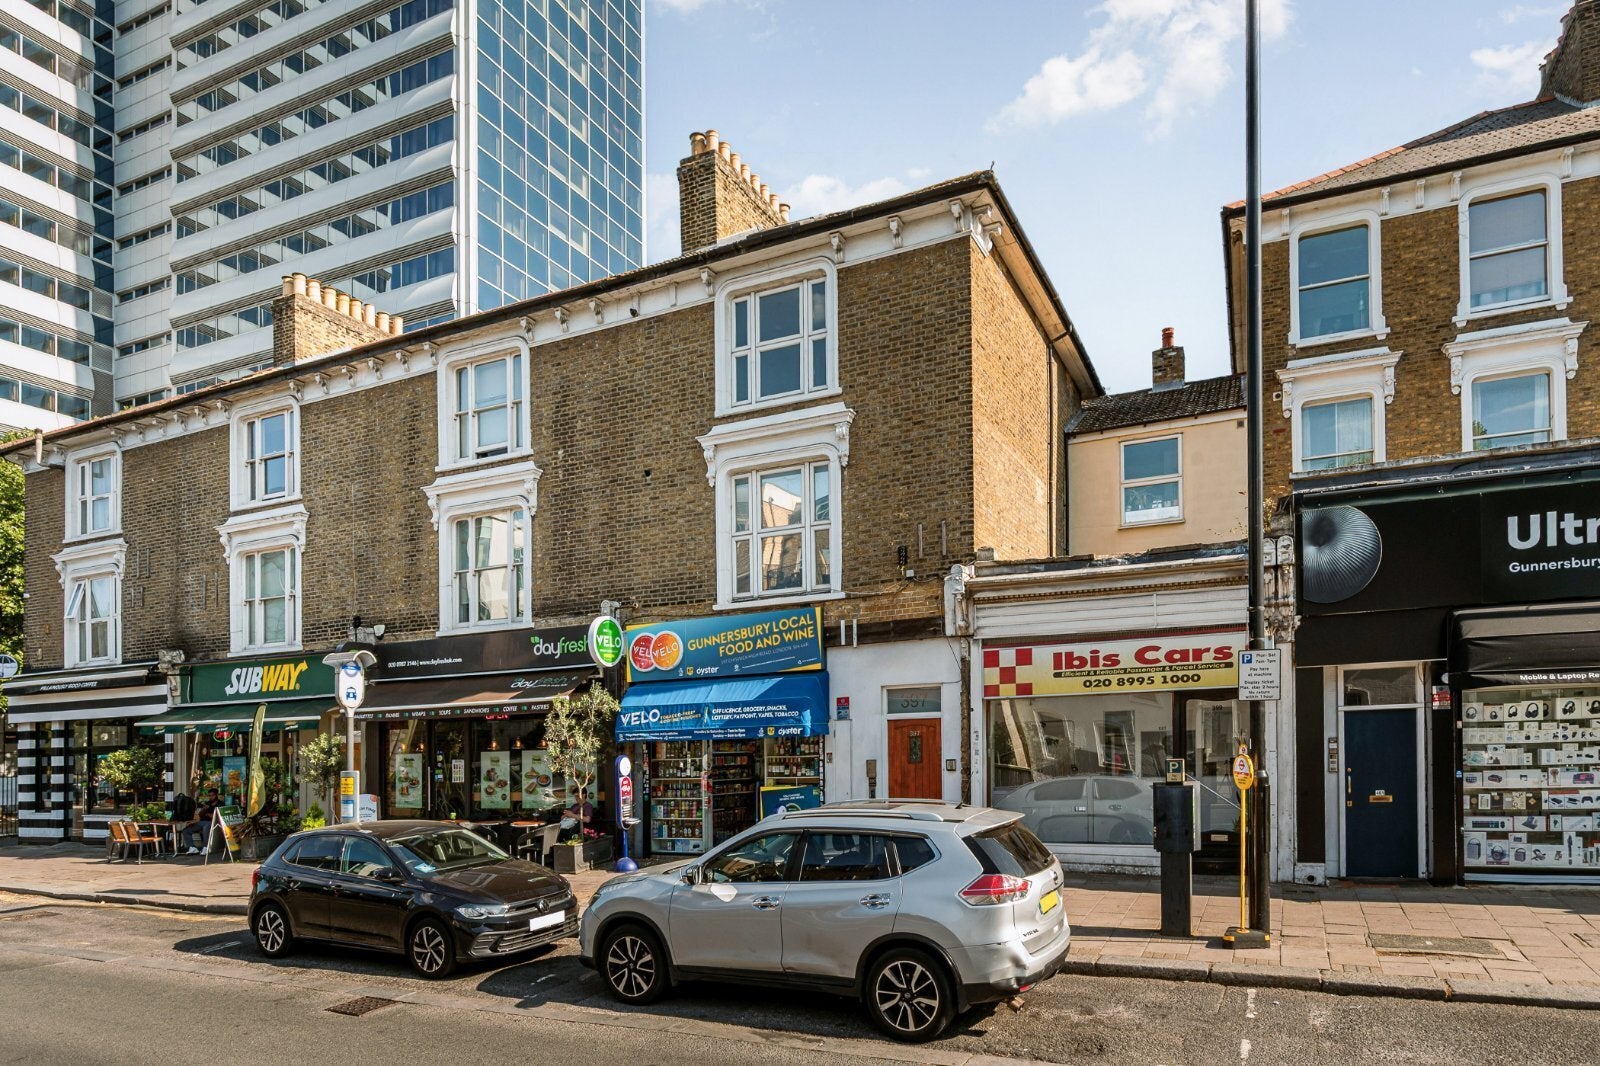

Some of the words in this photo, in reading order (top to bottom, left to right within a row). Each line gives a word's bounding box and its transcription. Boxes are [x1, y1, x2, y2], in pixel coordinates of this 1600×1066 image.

[1507, 511, 1600, 550] Ultr
[687, 622, 771, 651] GUNNERSBURY
[772, 613, 814, 632] LOCAL
[596, 634, 622, 648] VELO
[719, 640, 754, 657] FOOD
[755, 634, 781, 650] AND
[782, 626, 815, 642] WINE
[633, 646, 651, 658] VEL
[652, 642, 678, 658] VELO
[1053, 649, 1121, 671] Ibis
[1134, 645, 1234, 665] Cars
[224, 660, 308, 696] SUBWAY
[696, 666, 720, 674] oyster
[1083, 678, 1112, 688] 020
[1116, 676, 1155, 686] 8995
[1161, 674, 1201, 684] 1000
[901, 694, 926, 708] 397
[620, 709, 660, 726] VELO
[1170, 762, 1178, 772] P
